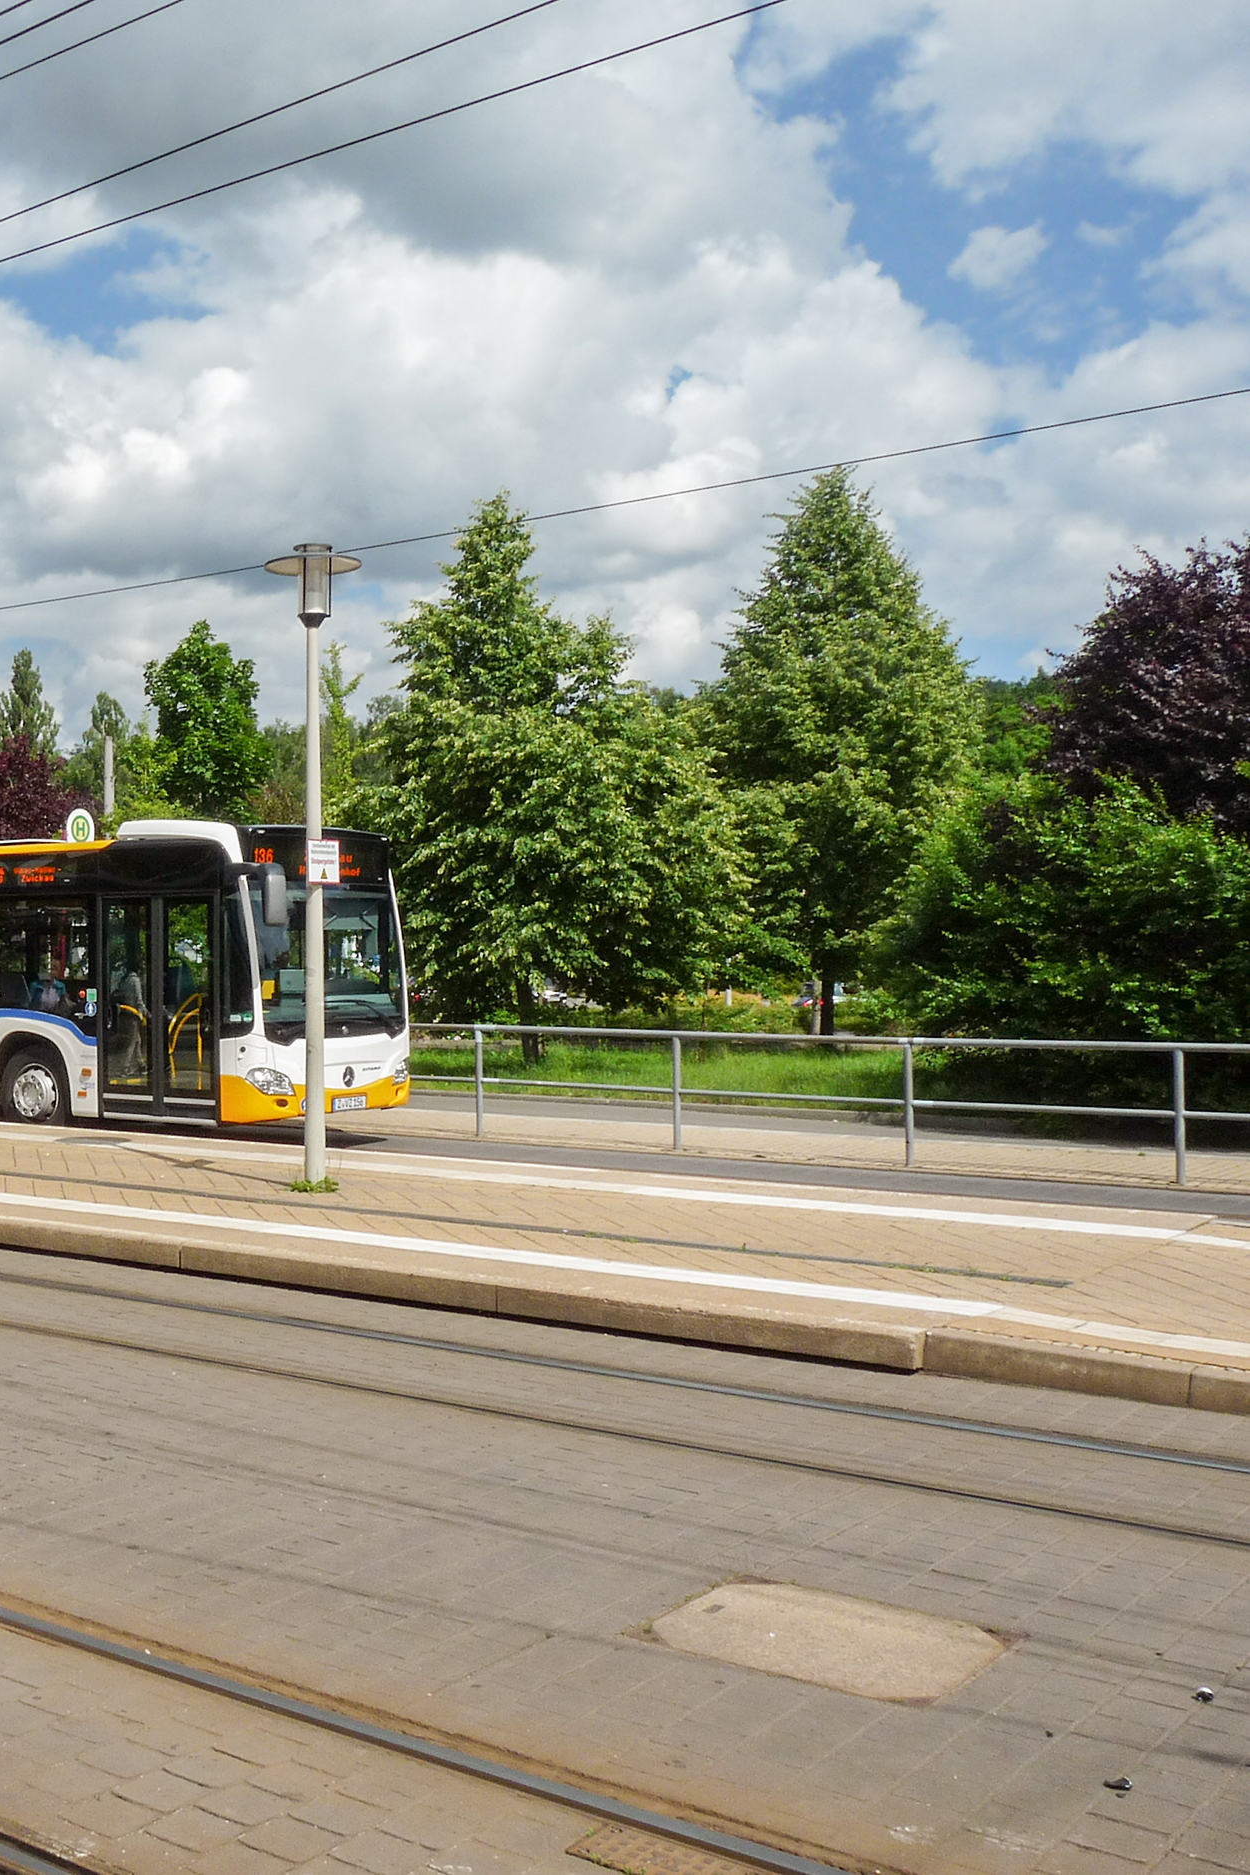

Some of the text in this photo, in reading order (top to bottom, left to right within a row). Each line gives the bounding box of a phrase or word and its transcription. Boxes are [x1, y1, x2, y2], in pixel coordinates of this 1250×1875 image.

[76, 821, 85, 837] H
[254, 848, 274, 863] 136
[20, 873, 54, 883] Zwickau
